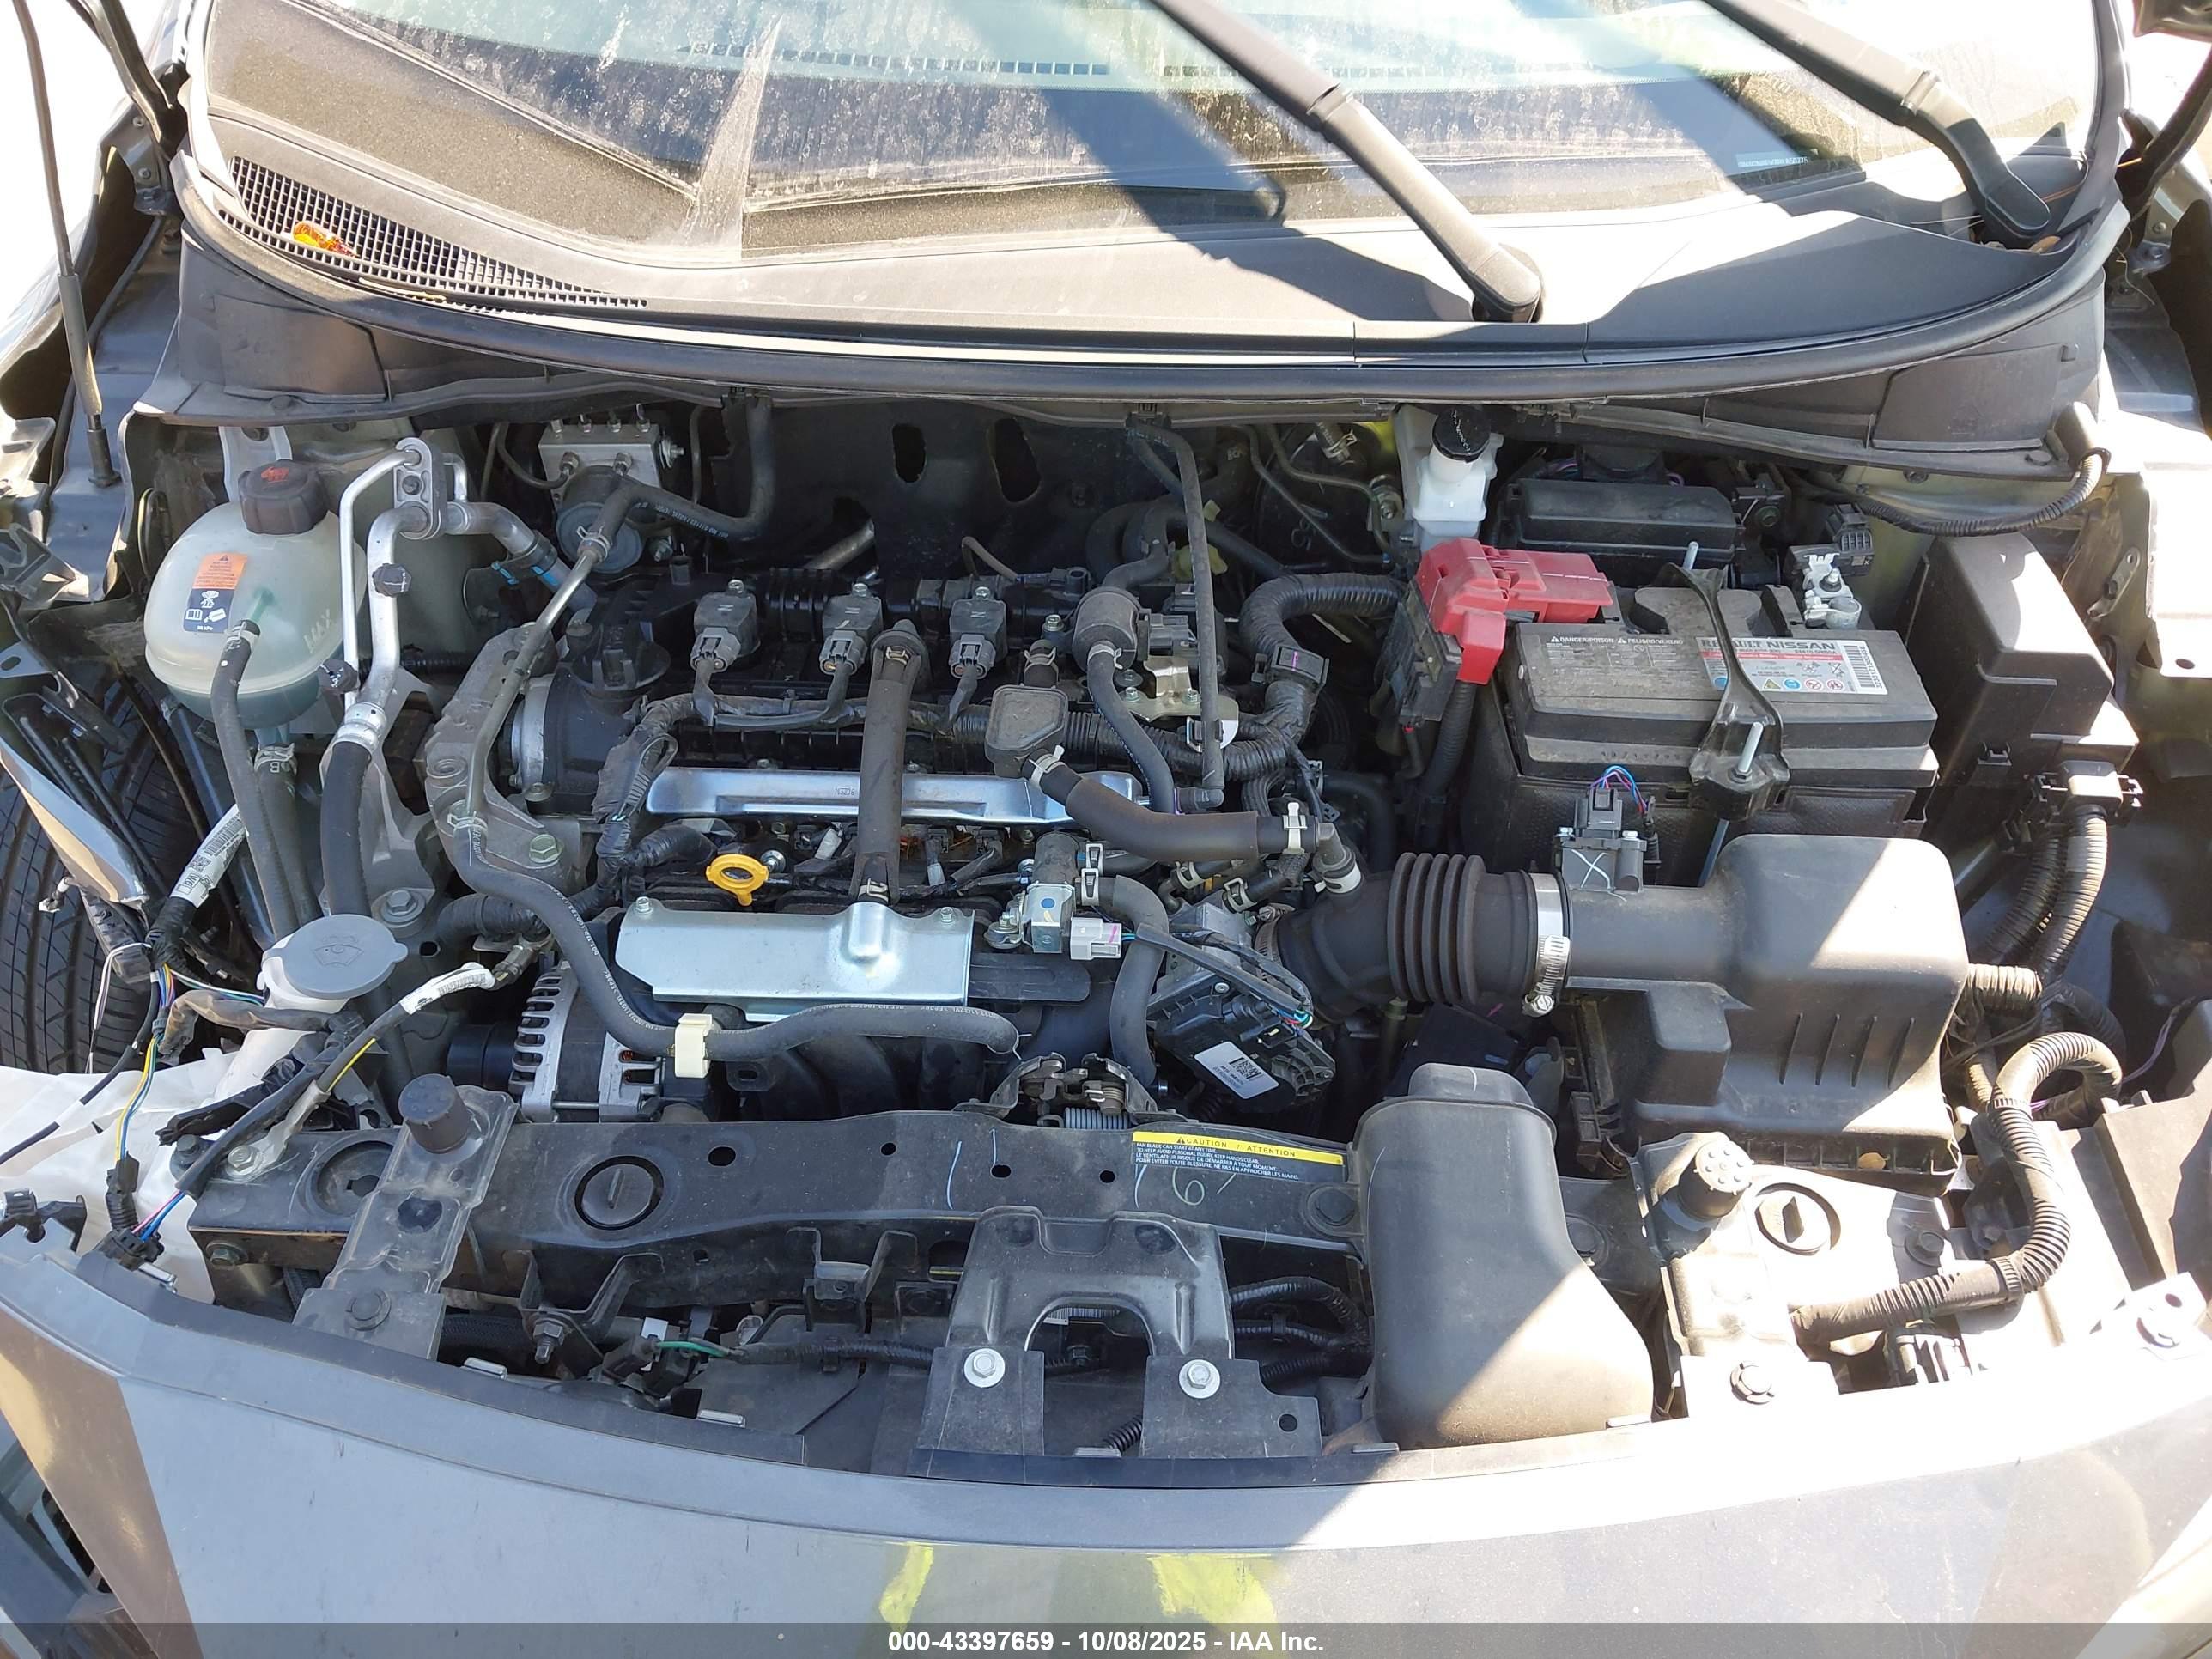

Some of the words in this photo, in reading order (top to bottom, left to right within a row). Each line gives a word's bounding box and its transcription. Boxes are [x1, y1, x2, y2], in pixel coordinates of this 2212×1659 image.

[1766, 641, 1836, 650] NISSAN
[1186, 1138, 1227, 1148] CAUTION
[1246, 1146, 1296, 1157] ATTENTION
